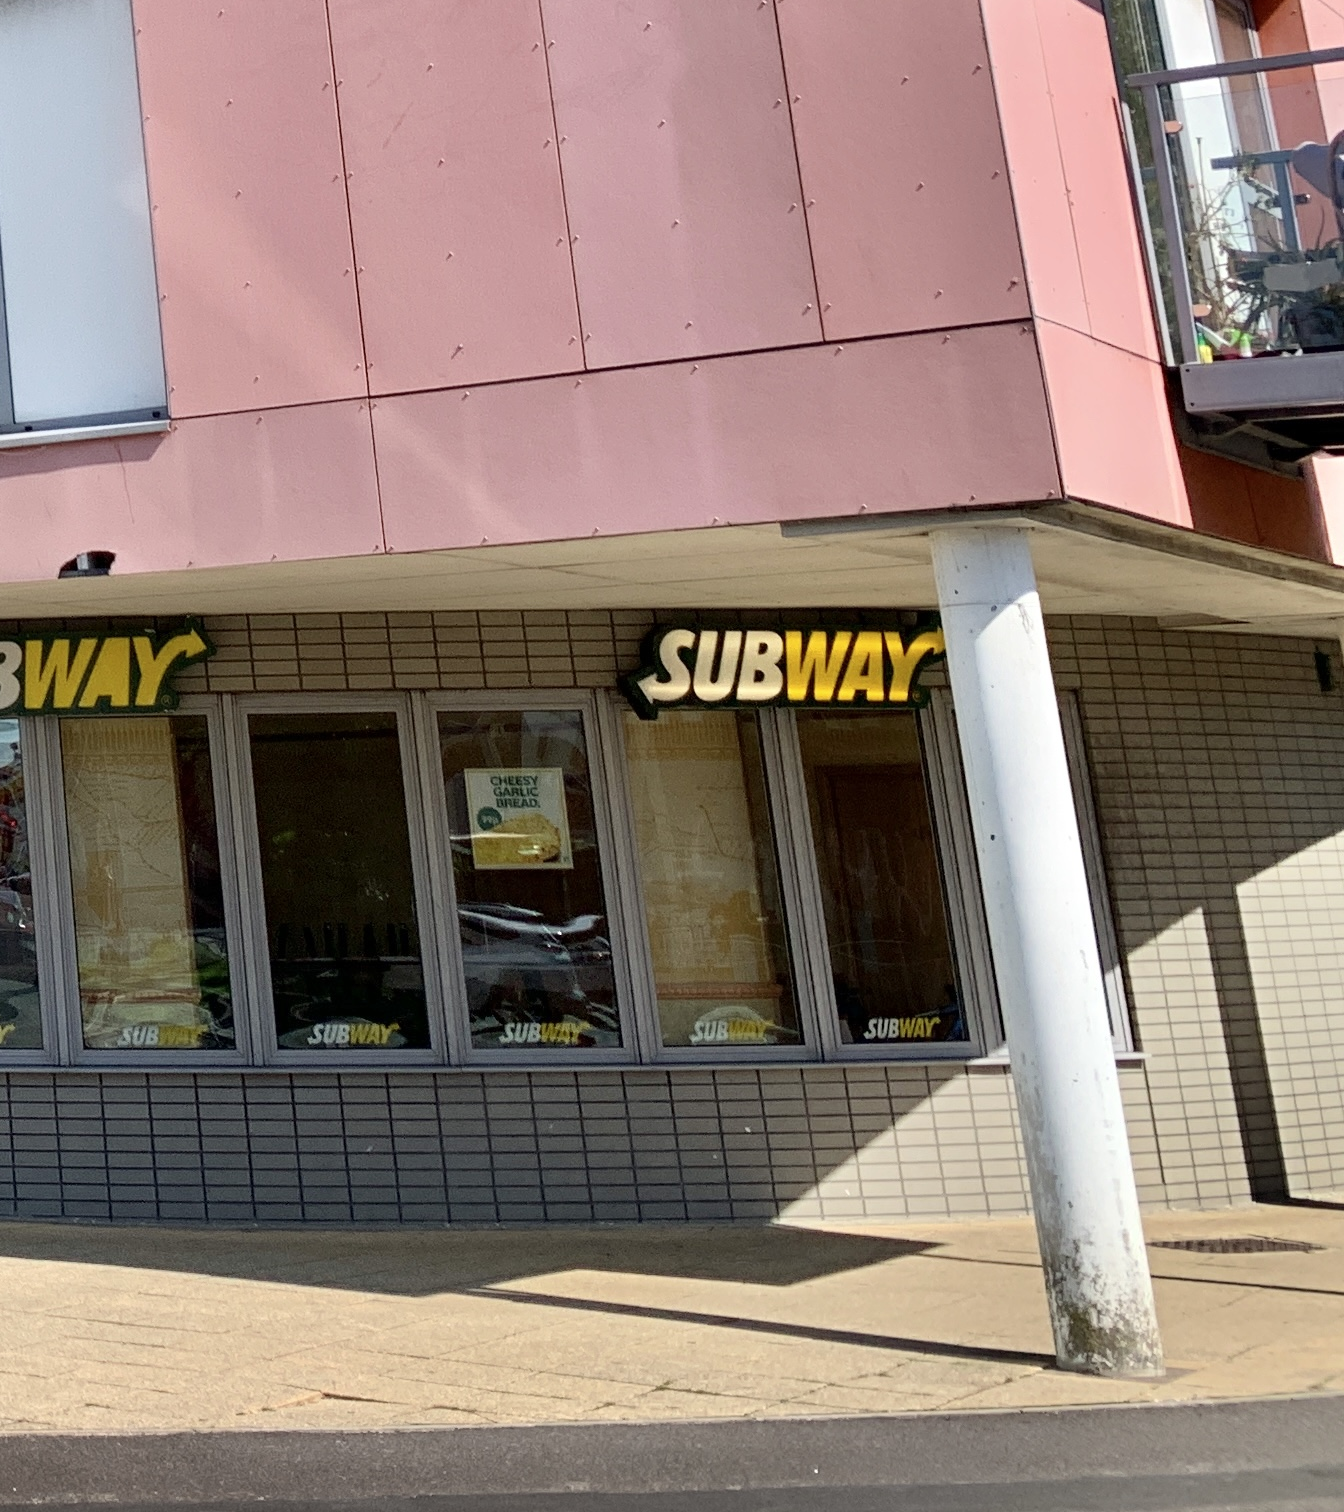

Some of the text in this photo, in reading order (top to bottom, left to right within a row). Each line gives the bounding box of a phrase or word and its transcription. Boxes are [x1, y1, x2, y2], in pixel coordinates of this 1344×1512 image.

[637, 627, 945, 705] SUBWAY
[490, 776, 538, 786] CHEESY
[493, 787, 539, 797] GARLIC
[119, 1024, 208, 1046] SUBWAY
[307, 1023, 400, 1045] SUBWAY
[499, 1020, 591, 1044] SUBWAY
[691, 1019, 773, 1045] SUBWAY
[863, 1016, 941, 1040] SUBWAY
